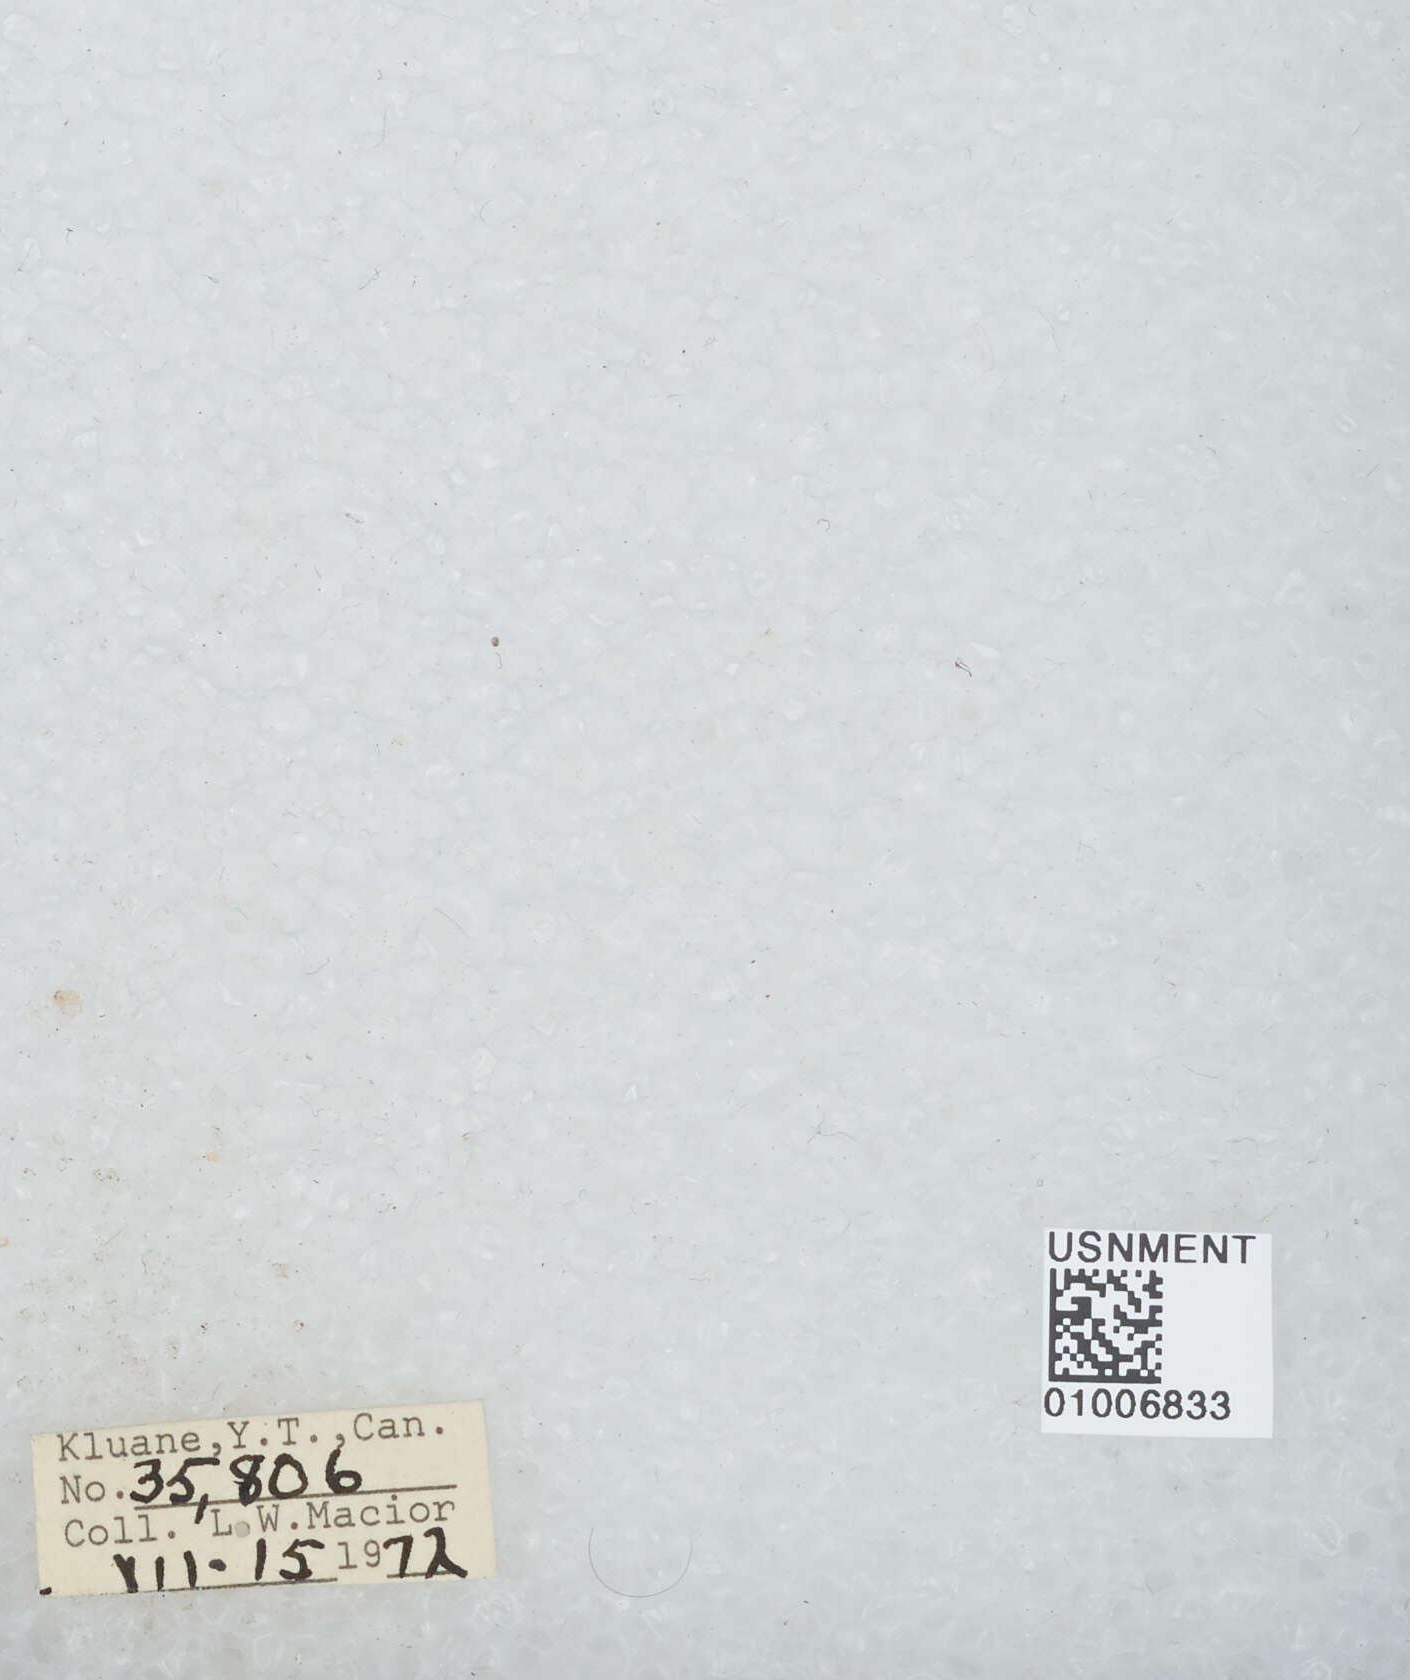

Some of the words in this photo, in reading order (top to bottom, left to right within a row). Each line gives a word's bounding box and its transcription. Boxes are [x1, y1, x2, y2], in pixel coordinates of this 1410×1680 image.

[1048, 1231, 1257, 1264] USNMENT
[1043, 1387, 1231, 1420] 01006833
[64, 1513, 176, 1547] Coll.
